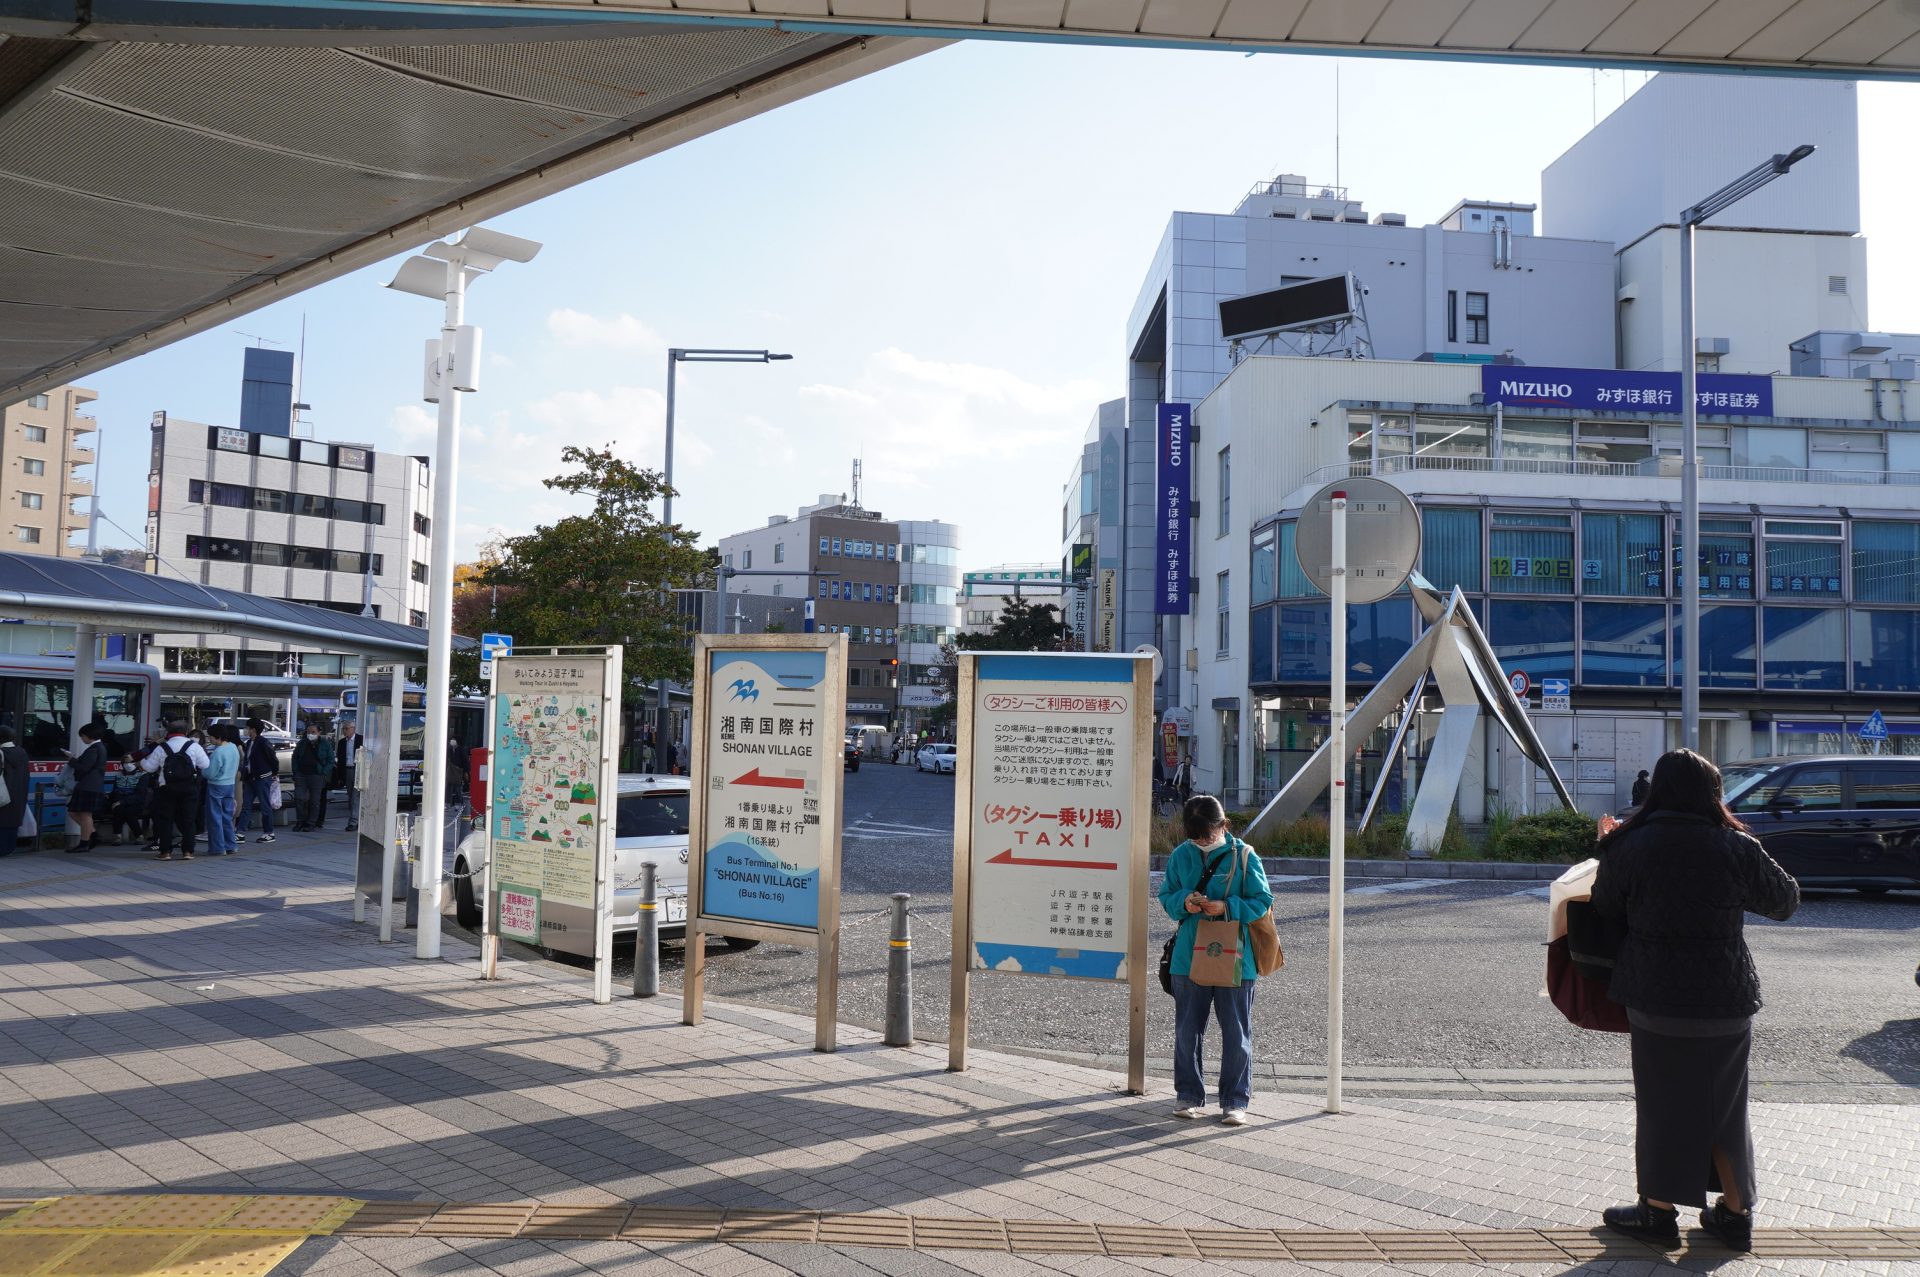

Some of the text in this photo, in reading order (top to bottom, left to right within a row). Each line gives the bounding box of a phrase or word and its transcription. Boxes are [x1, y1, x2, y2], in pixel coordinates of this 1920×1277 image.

[1500, 380, 1573, 398] MIZUHO
[1596, 388, 1673, 405] みずほ銀行
[1167, 414, 1182, 603] MIZUHO みずほ銀行 みずほ証券
[514, 668, 584, 678] 歩いてみよう逗子・葉山
[1514, 678, 1524, 689] 30
[990, 696, 1124, 712] タクシーご利用の皆様へ
[720, 716, 814, 736] 湘南国際村
[994, 724, 1115, 735] この場所は一般車の乗降場です
[994, 735, 1116, 746] タクシー乗り場ではございません。
[722, 742, 812, 756] SHONAN VILLAGE
[994, 745, 1114, 756] 当場所でのタクシー利用は一般車
[994, 755, 1114, 766] へのご迷惑になりますので、構内
[994, 765, 1113, 776] 乗り入れ許可されております
[993, 775, 1113, 788] タクシー乗り場をご利用下さい。
[738, 802, 792, 815] 1番乗り場より
[803, 814, 819, 825] SCUM
[984, 803, 1122, 830] (タクシー乗り場)
[724, 816, 805, 835] 湘南国際村行
[746, 835, 780, 847] (16系統)
[1014, 830, 1089, 848] TAXI
[727, 856, 798, 871] Bus Terminal No.1
[739, 889, 784, 903] (Bus No.16)
[1050, 890, 1113, 901] JR逗子駅長
[501, 904, 535, 919] 多発しています
[1050, 902, 1113, 913] 逗子市役所
[502, 915, 534, 931] ご注意ください
[1050, 915, 1113, 926] 逗子警察署
